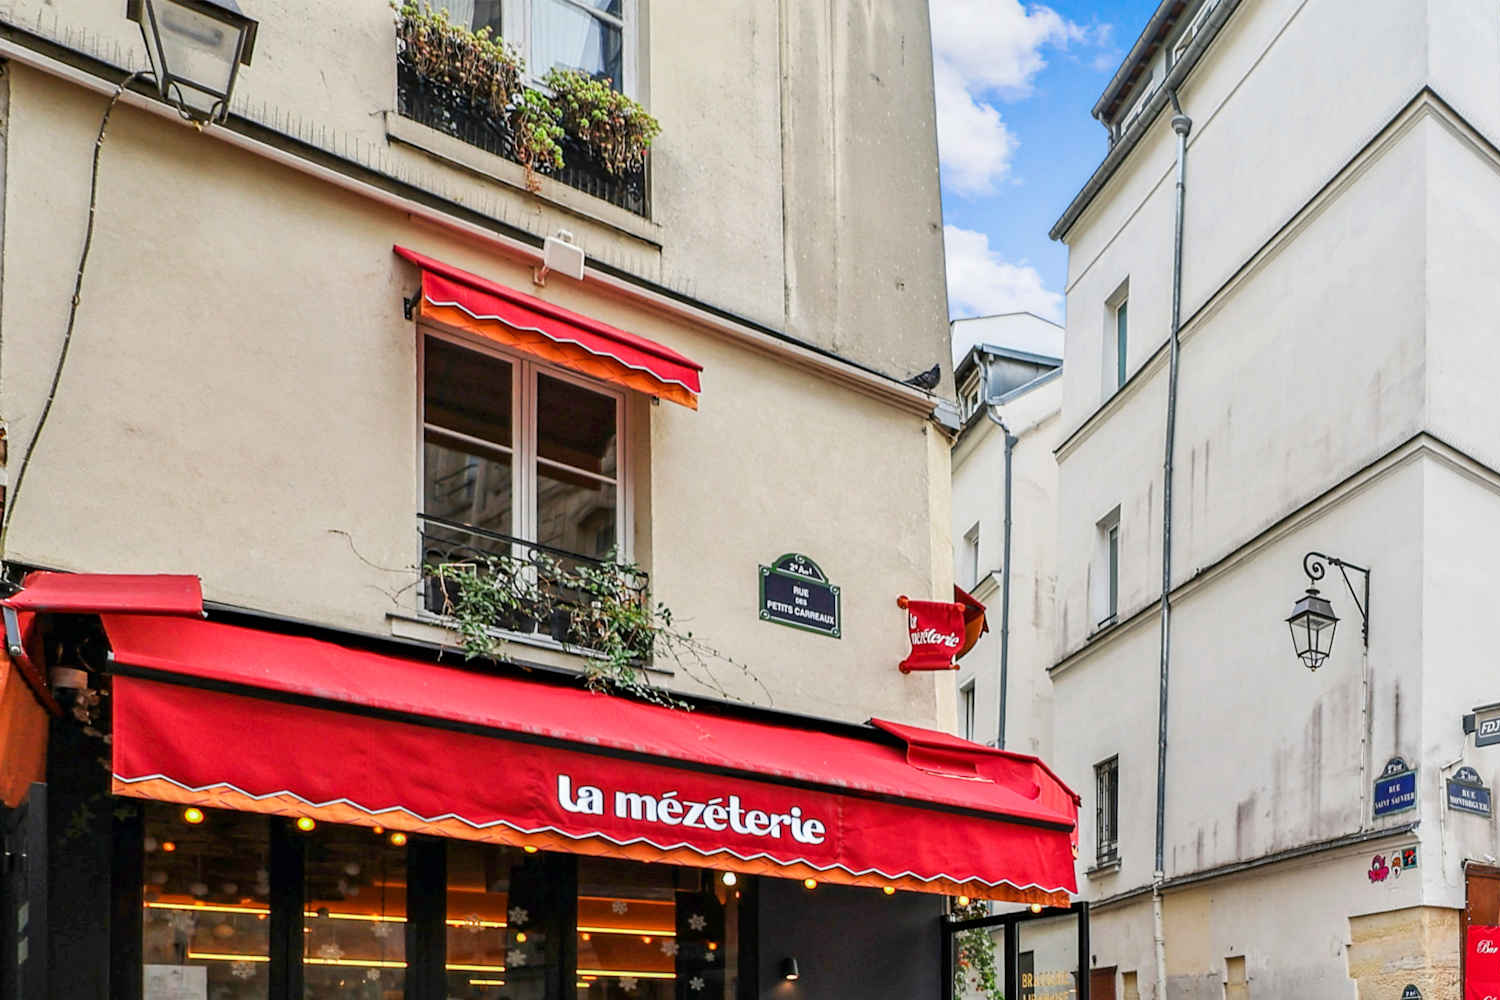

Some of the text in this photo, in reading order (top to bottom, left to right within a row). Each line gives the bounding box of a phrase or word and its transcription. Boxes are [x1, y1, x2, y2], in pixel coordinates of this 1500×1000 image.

[793, 585, 809, 598] RUE
[795, 597, 807, 606] DES
[767, 600, 835, 625] PETITS CARREAUX
[1480, 719, 1500, 735] FDJ
[1388, 784, 1401, 793] RUE
[1462, 789, 1476, 799] RUE
[557, 774, 827, 845] la mézéterie
[1375, 799, 1390, 809] SAINT
[1477, 939, 1498, 954] Bar
